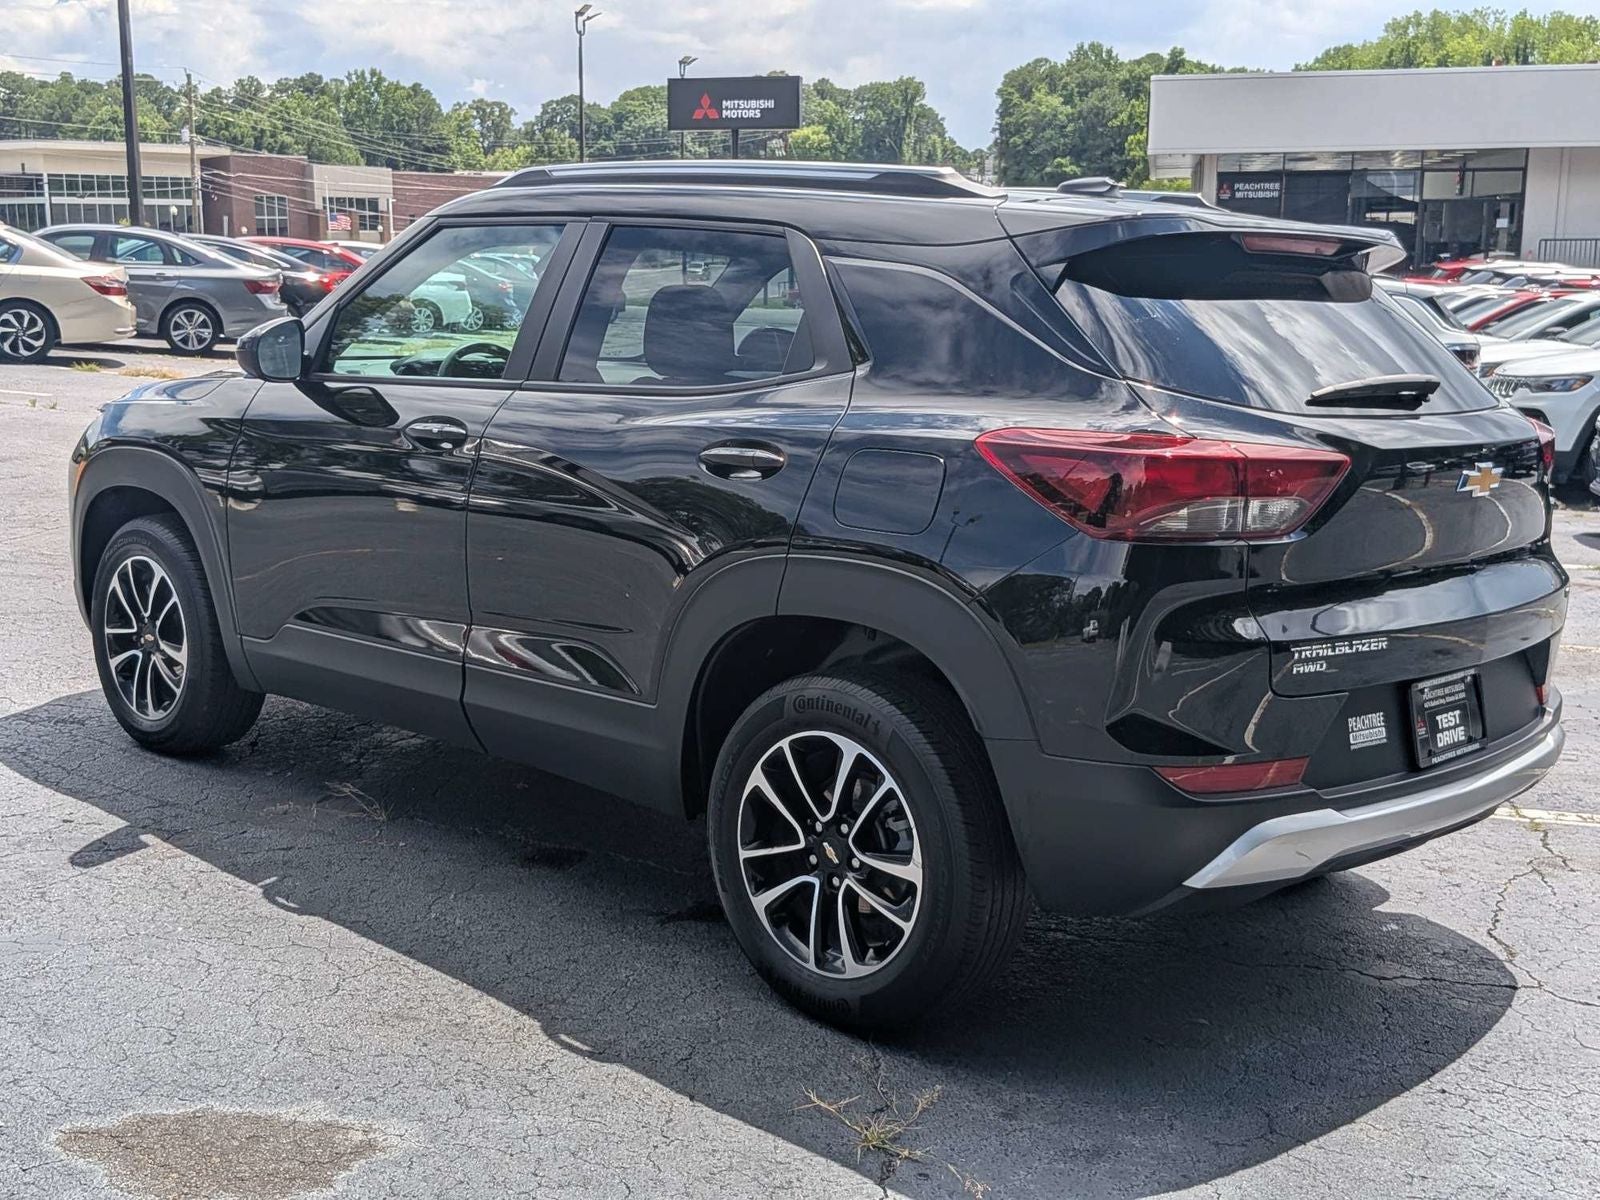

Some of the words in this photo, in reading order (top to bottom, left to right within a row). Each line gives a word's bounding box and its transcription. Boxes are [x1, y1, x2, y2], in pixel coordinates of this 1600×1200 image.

[722, 99, 774, 109] MITSUBISHI
[722, 109, 761, 119] MOTORS
[1234, 182, 1280, 190] PEACHTREE
[1235, 190, 1279, 199] MITSUBISHI
[1291, 637, 1388, 660] TRAILBLAZER
[1292, 660, 1327, 674] AWD
[793, 695, 872, 728] Continental
[1348, 711, 1385, 732] PEACHTREE
[1435, 709, 1460, 729] TEST
[1351, 729, 1384, 742] Mitsubishi
[1436, 725, 1466, 748] DRIVE
